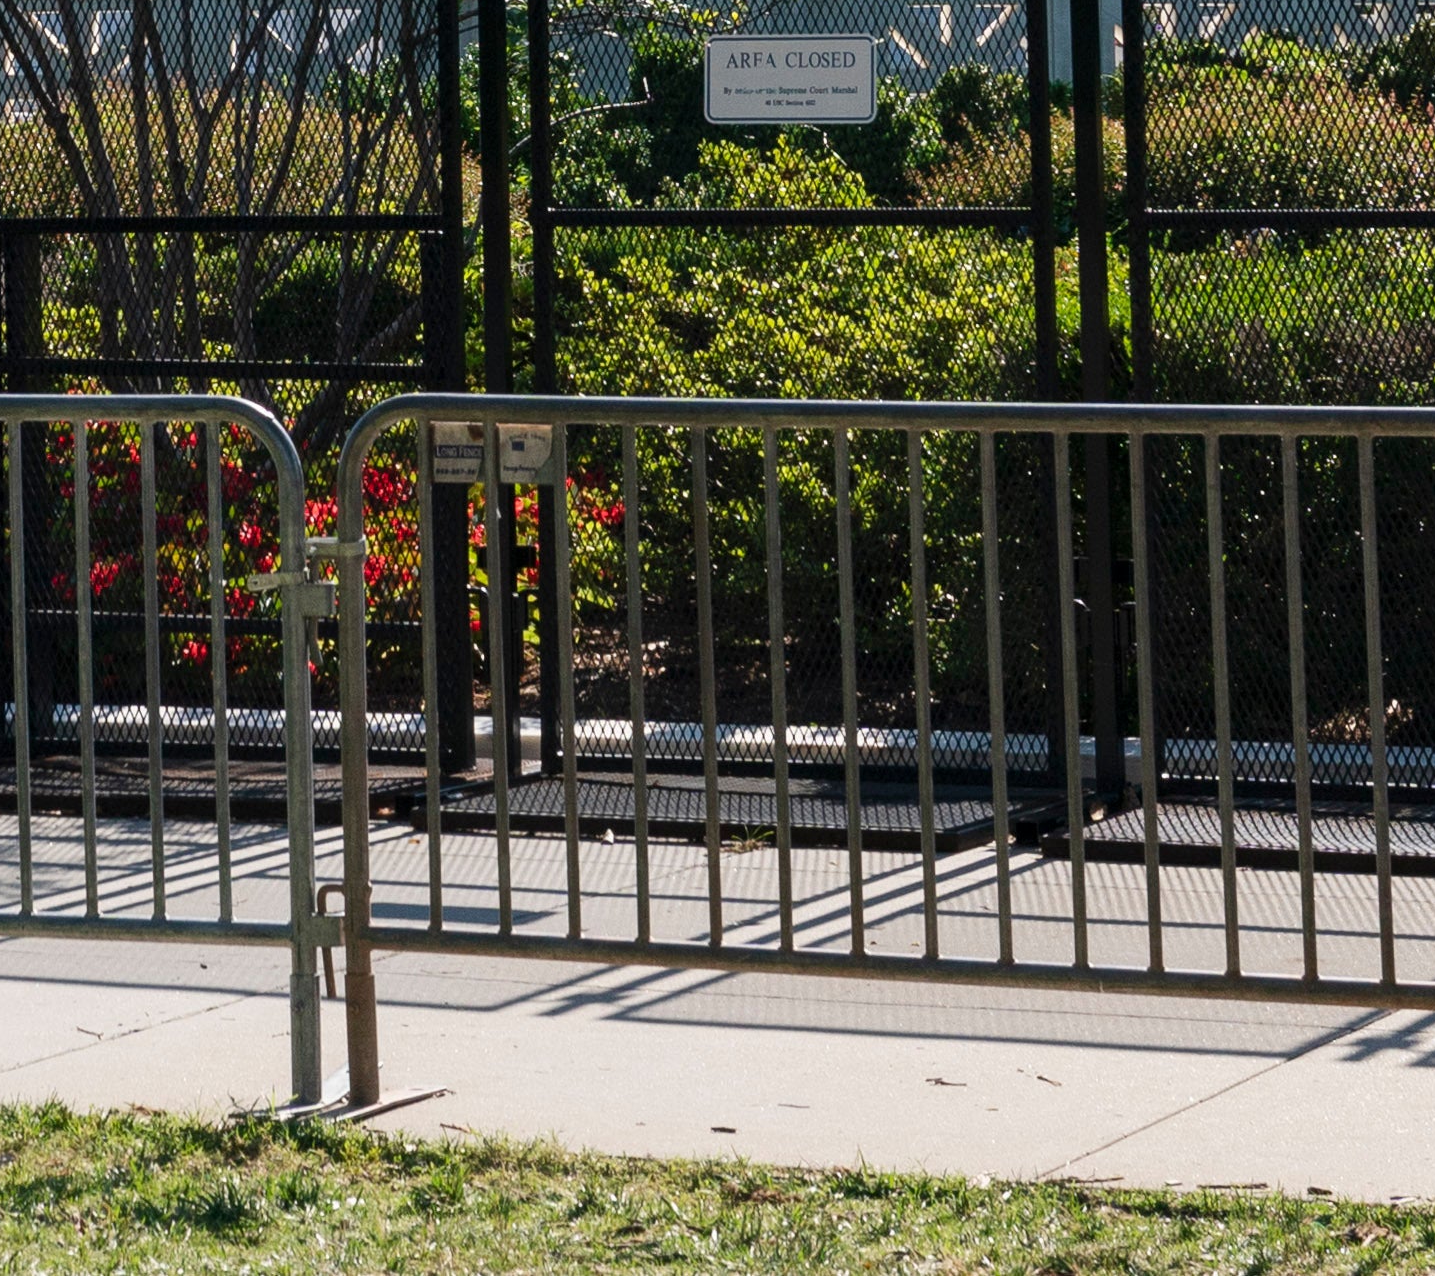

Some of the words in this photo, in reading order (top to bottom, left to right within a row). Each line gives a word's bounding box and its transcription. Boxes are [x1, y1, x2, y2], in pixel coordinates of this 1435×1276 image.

[785, 51, 856, 69] CLOSED
[809, 86, 829, 95] Court
[831, 86, 858, 95] Marshal
[436, 446, 457, 457] LONG
